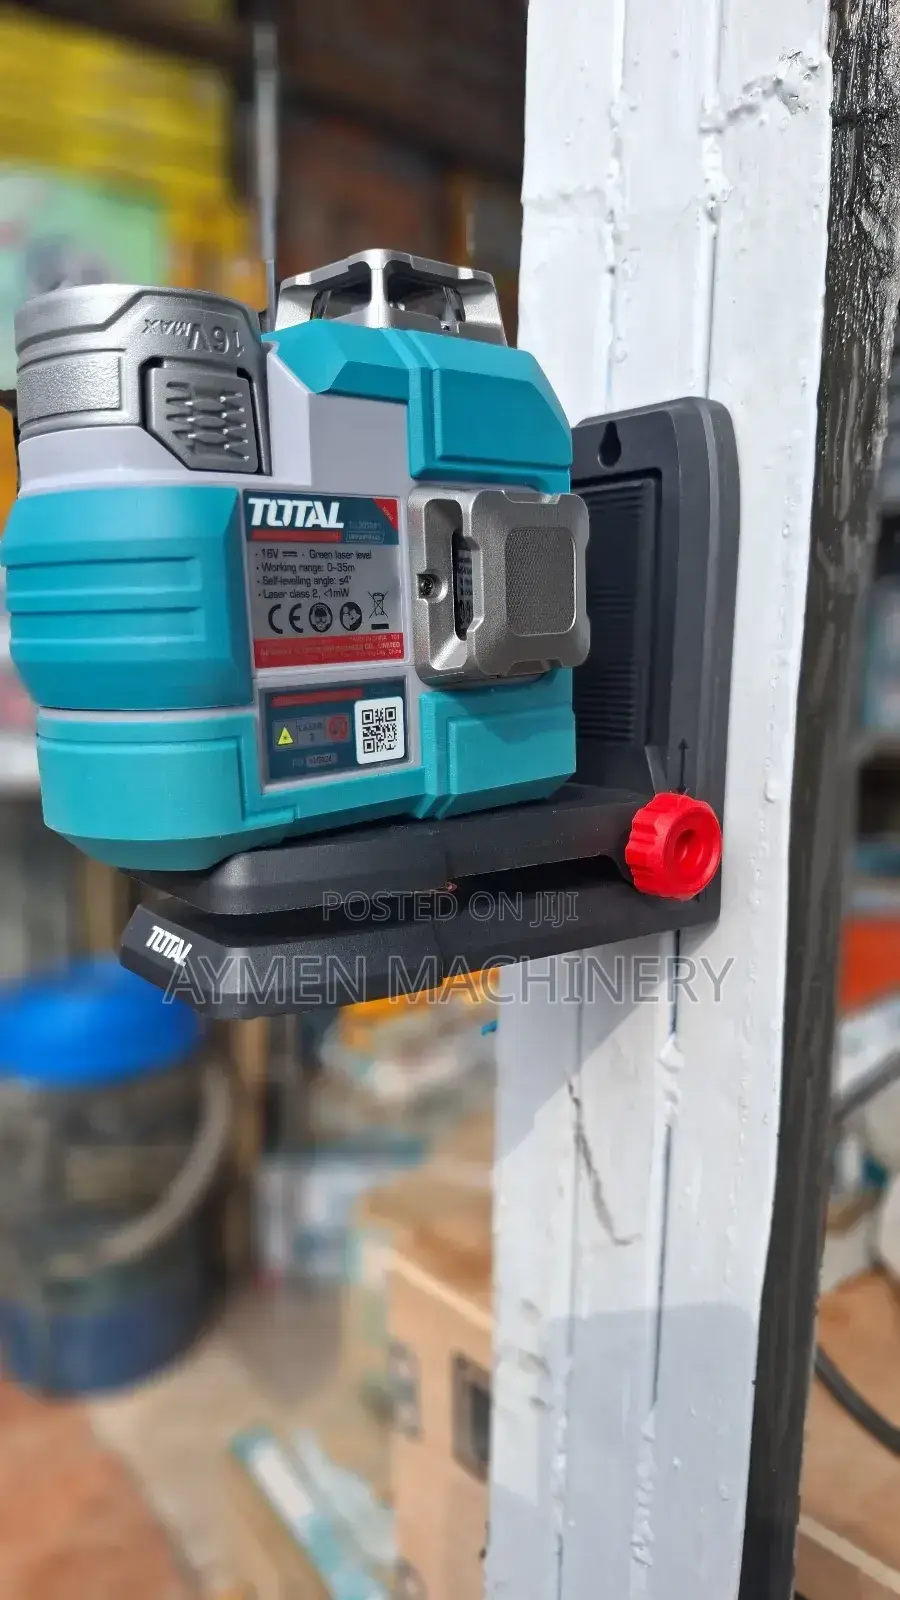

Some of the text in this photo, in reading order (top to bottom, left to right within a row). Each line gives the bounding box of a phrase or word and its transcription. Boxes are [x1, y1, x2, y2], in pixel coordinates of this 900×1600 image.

[247, 498, 345, 529] TOTAL
[261, 548, 372, 560] 16V Green laser level
[261, 562, 297, 574] Working
[299, 564, 324, 574] range:
[262, 575, 311, 587] Self-levelling
[313, 577, 336, 588] angle:
[263, 589, 287, 599] Laser
[289, 589, 310, 598] class
[323, 587, 350, 598] <1mW
[146, 925, 192, 967] TOTAL
